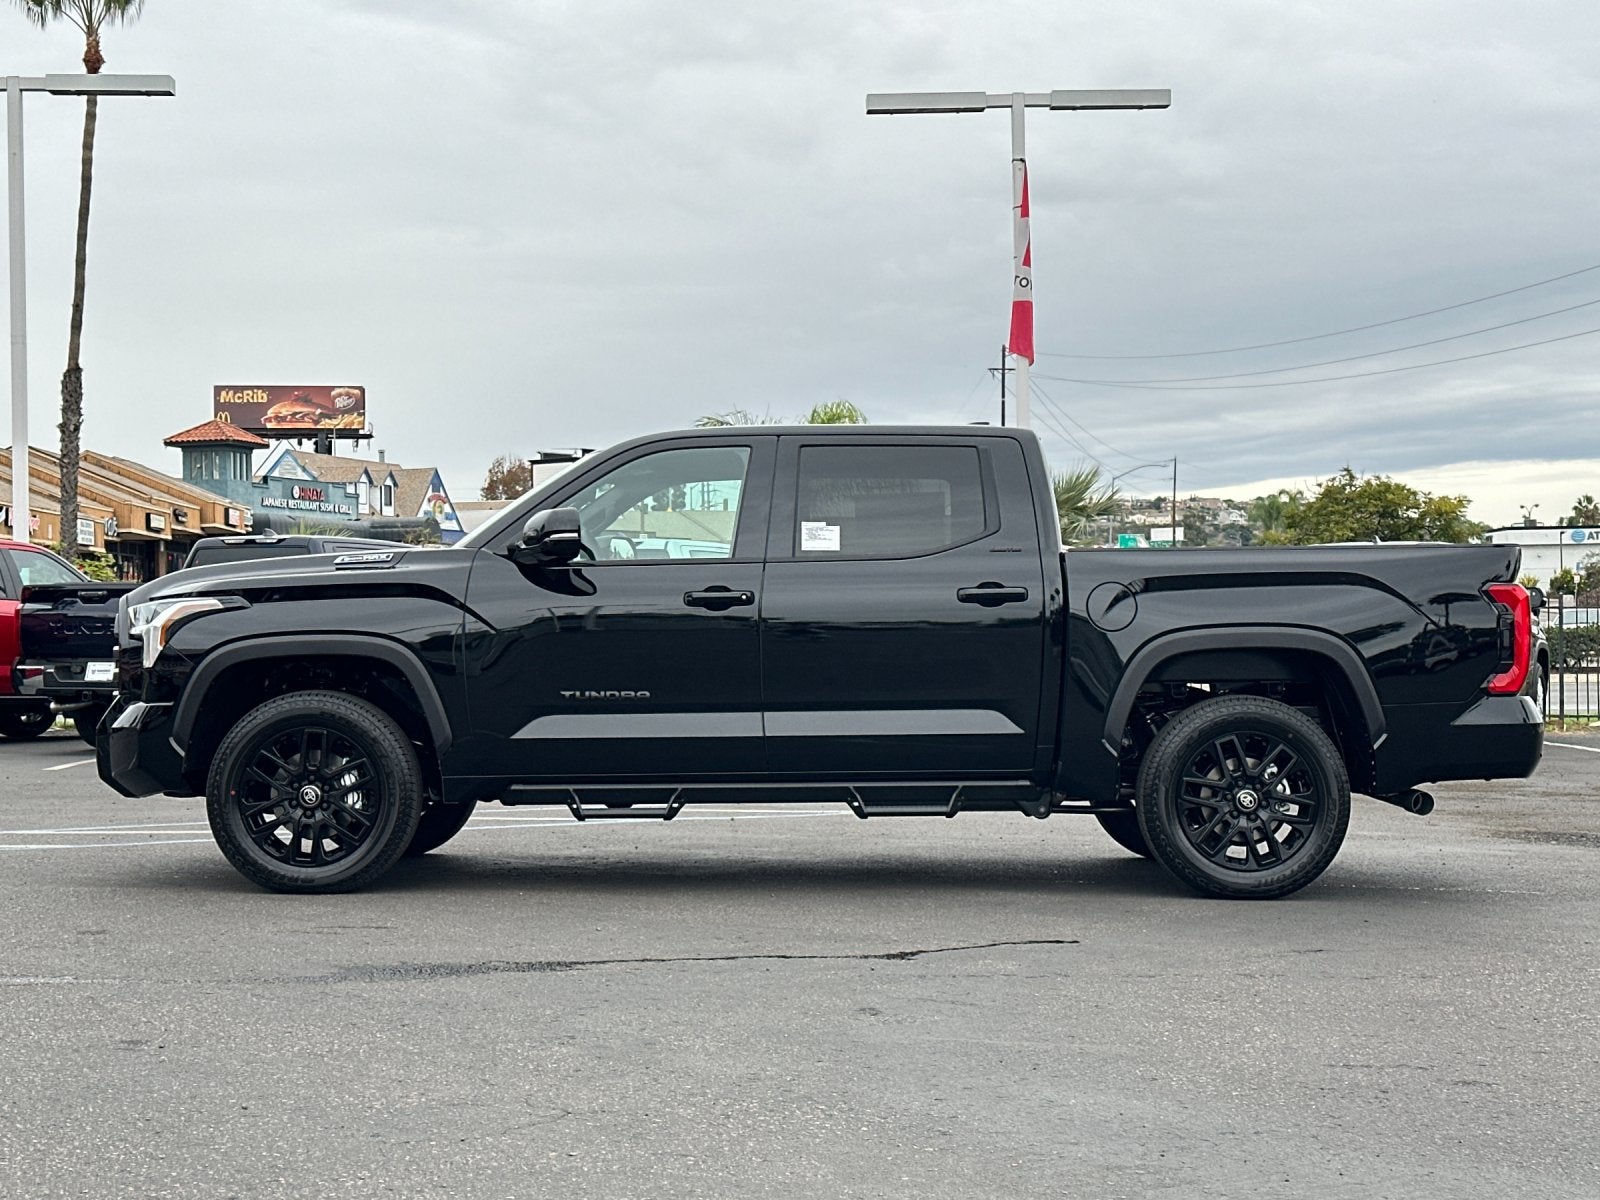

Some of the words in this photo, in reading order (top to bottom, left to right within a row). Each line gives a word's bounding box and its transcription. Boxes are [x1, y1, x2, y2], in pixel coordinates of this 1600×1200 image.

[220, 389, 268, 403] McRib
[299, 486, 325, 501] HINATA
[262, 497, 287, 509] JAPANESE
[288, 499, 320, 511] RESTAURANT
[320, 503, 334, 512] SUSHI
[339, 504, 352, 514] GRILL
[560, 690, 651, 699] TUNDRA
